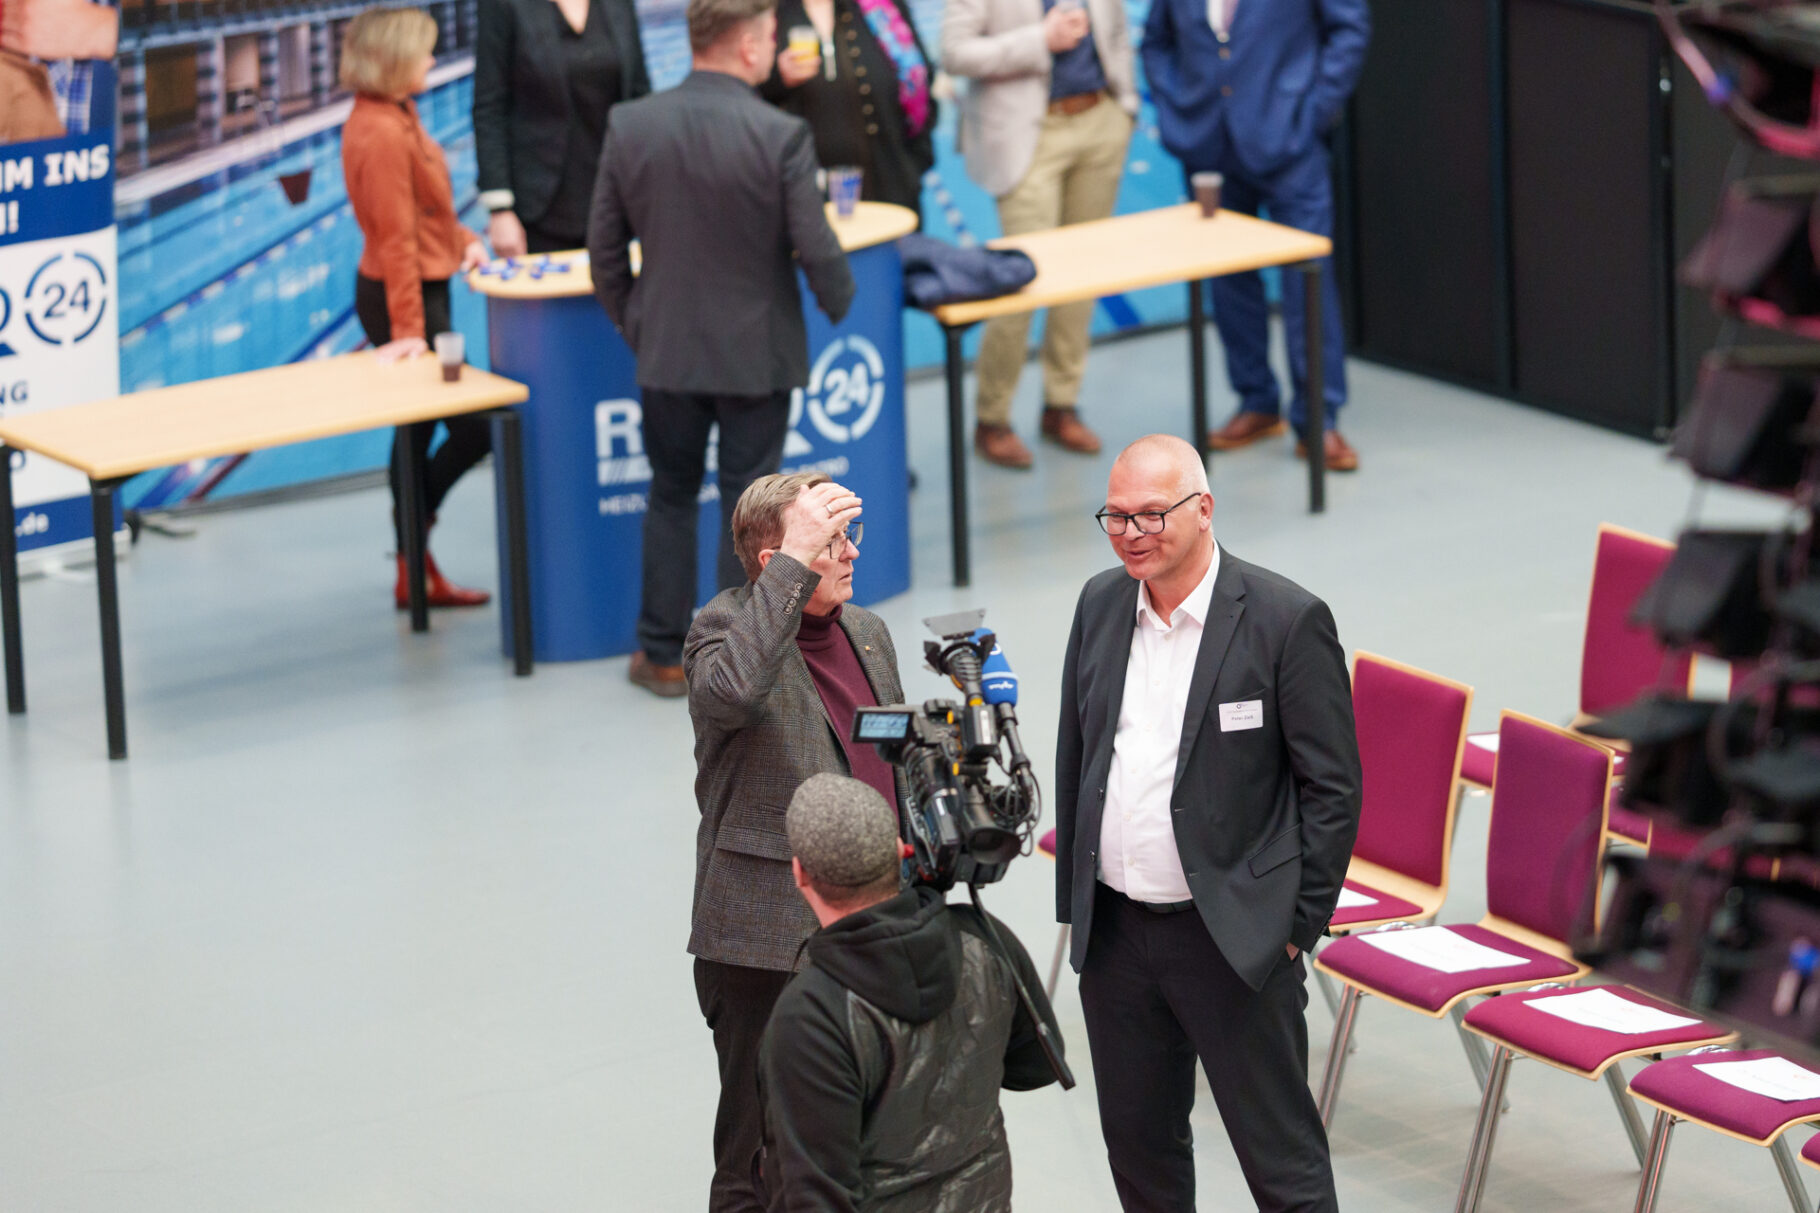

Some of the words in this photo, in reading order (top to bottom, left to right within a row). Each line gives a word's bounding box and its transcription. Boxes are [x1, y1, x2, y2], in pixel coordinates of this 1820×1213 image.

[0, 156, 34, 194] M
[44, 143, 110, 187] INS
[44, 279, 90, 318] 24
[824, 363, 868, 416] 24
